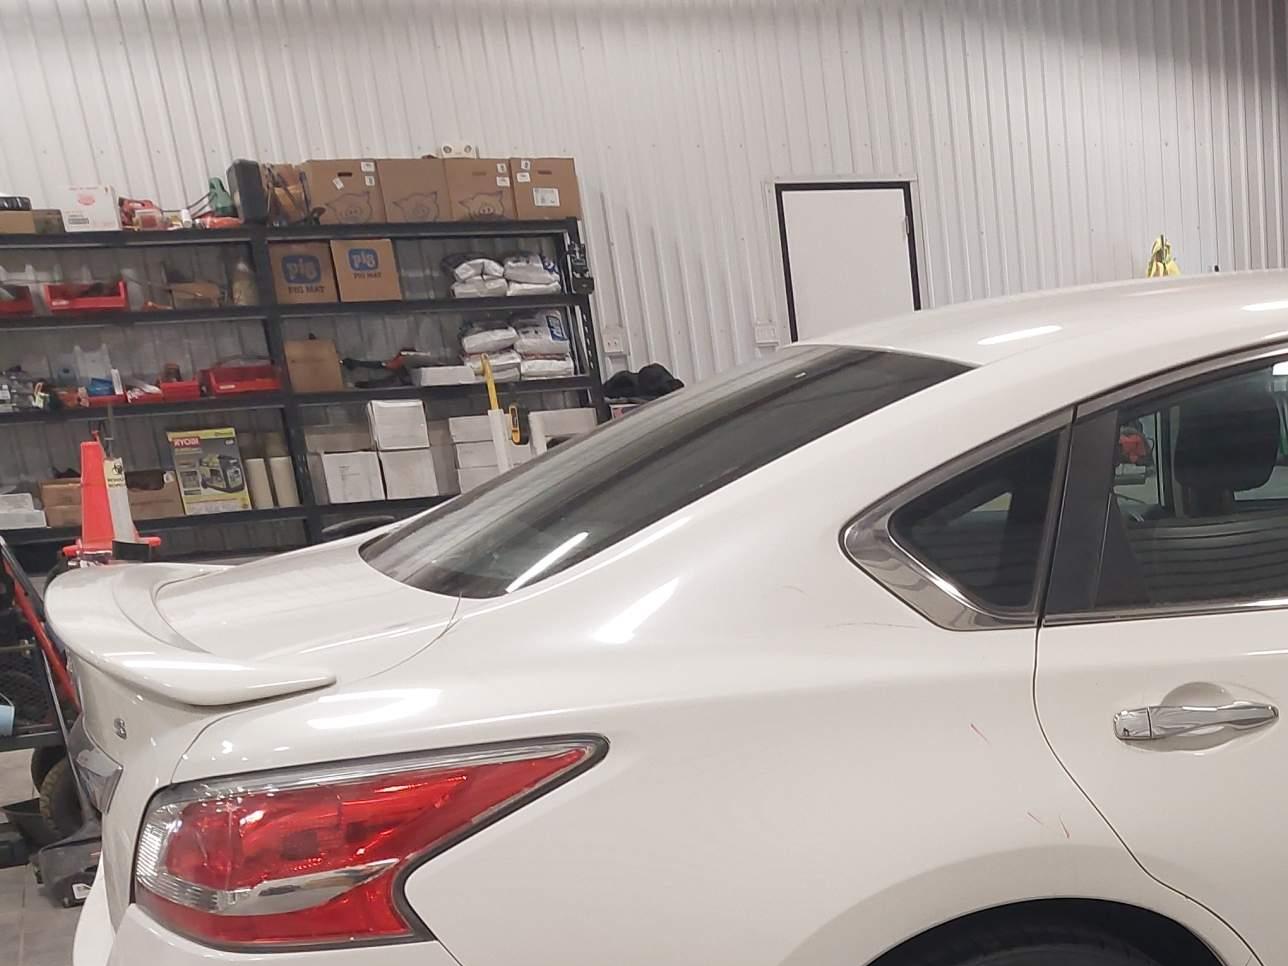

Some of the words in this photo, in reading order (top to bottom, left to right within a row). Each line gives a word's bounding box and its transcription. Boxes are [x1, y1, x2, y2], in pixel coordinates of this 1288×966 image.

[352, 249, 376, 269] pig
[286, 258, 317, 281] pig
[174, 437, 199, 447] RYOBI
